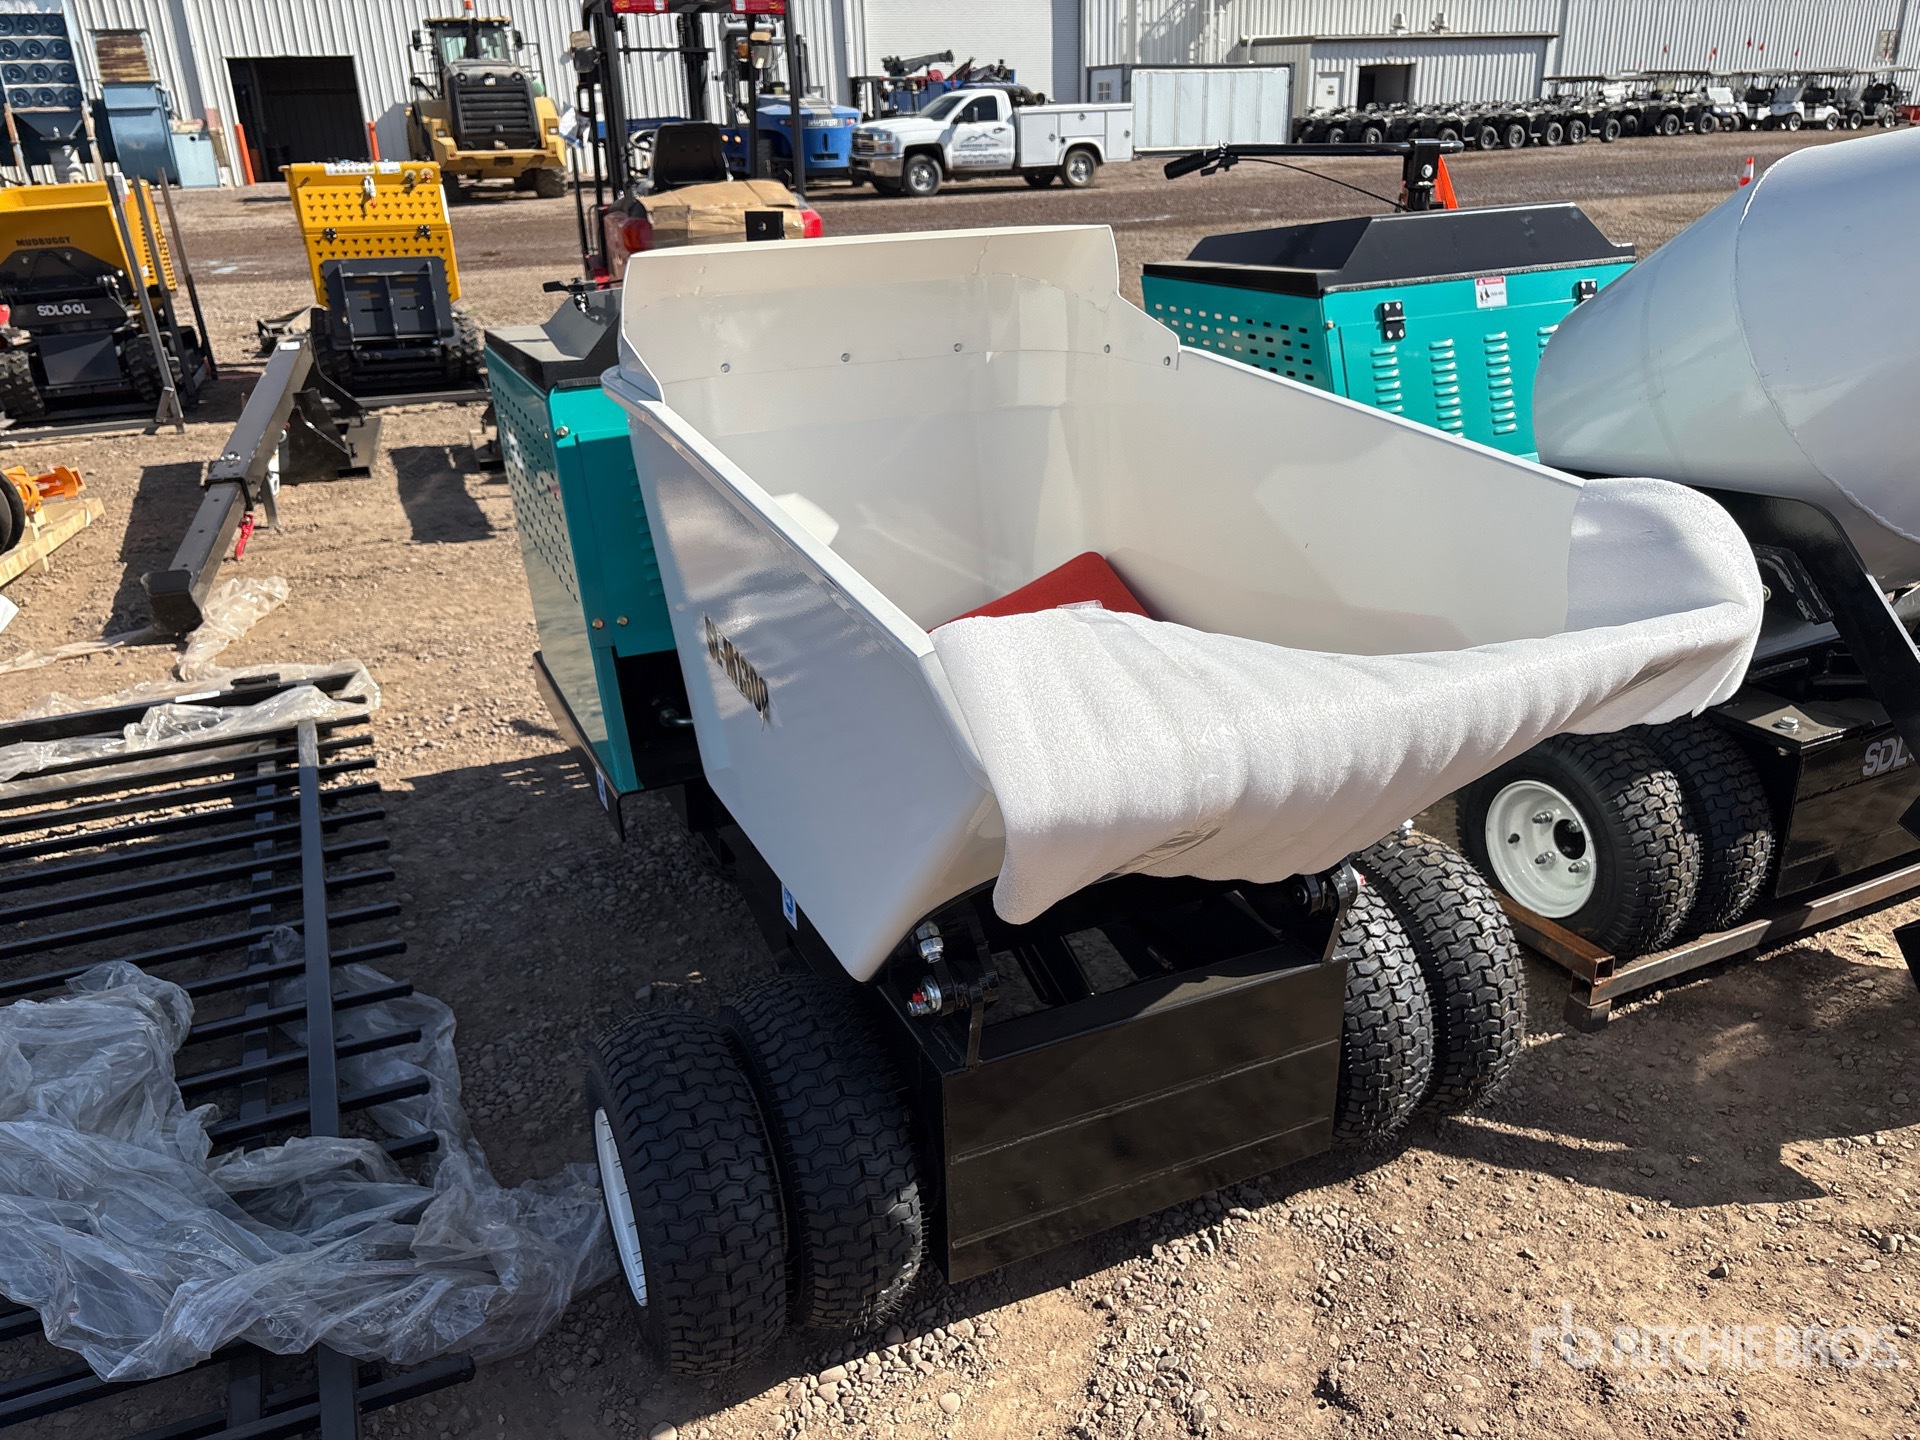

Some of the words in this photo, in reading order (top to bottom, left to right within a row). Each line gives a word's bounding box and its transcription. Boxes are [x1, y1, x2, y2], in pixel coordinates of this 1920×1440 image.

[16, 236, 71, 246] MUDBUGGY
[37, 303, 91, 316] SDLOOL
[1862, 736, 1915, 776] SDL
